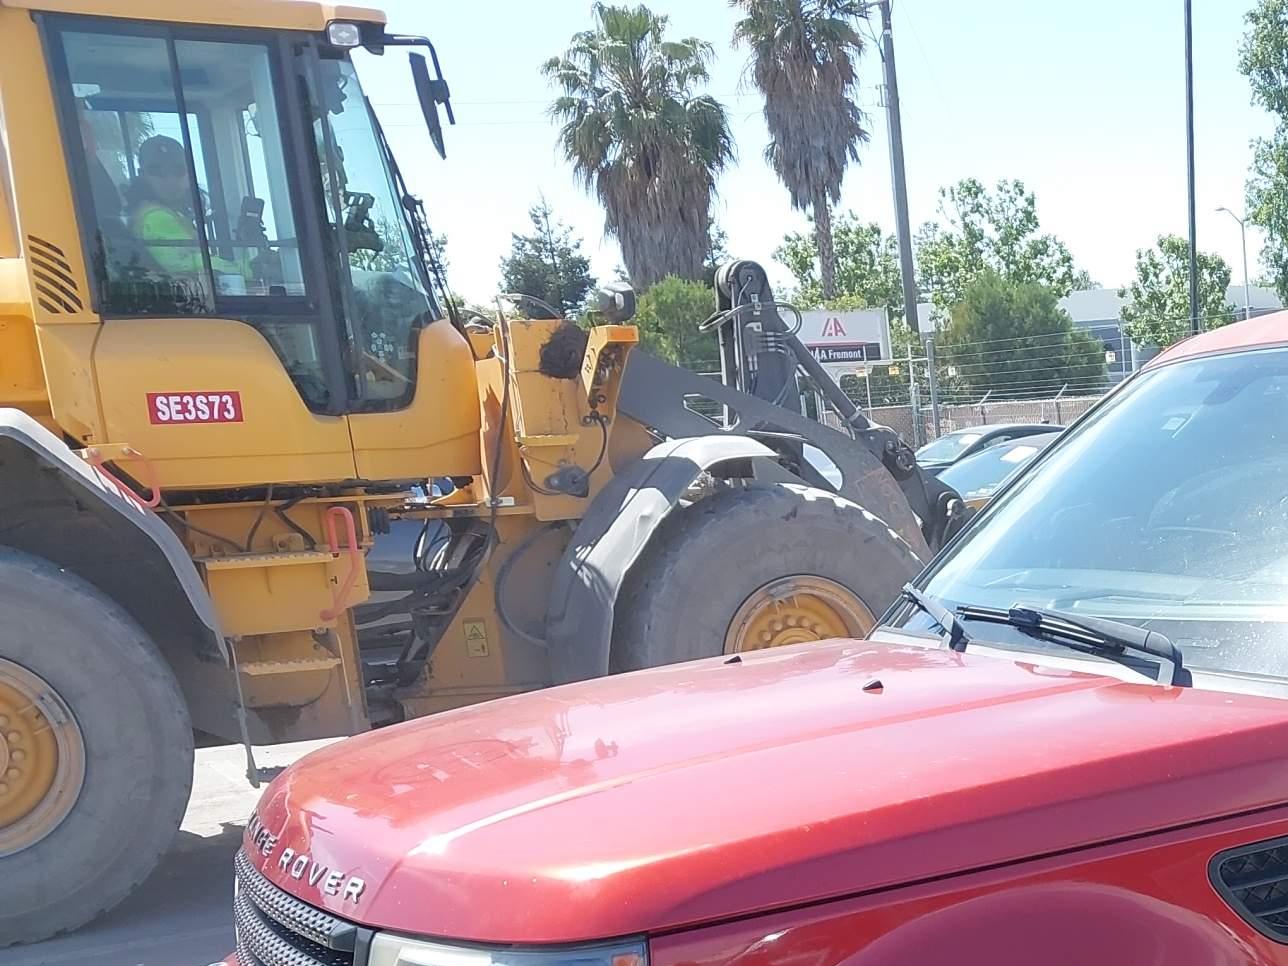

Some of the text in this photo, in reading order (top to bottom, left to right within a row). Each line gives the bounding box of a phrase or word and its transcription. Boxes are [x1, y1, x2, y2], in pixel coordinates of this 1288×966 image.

[828, 349, 862, 360] Fremont
[155, 394, 236, 421] SE3S73
[278, 847, 366, 904] ROVER
